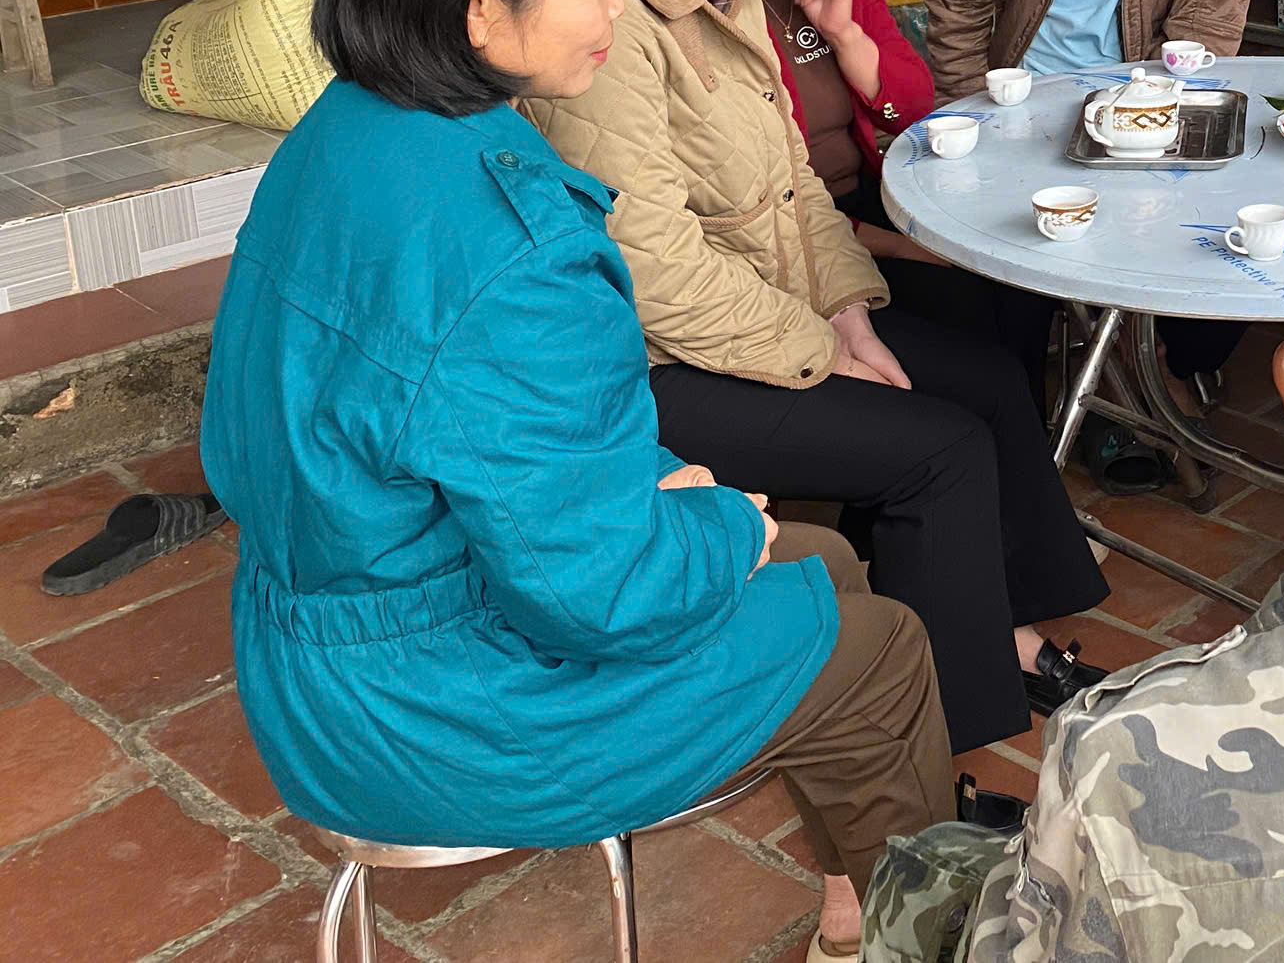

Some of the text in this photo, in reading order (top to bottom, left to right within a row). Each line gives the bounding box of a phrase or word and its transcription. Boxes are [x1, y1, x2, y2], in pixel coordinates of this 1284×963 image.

[159, 62, 185, 107] TRÂU
[1191, 236, 1277, 286] PE Protective
